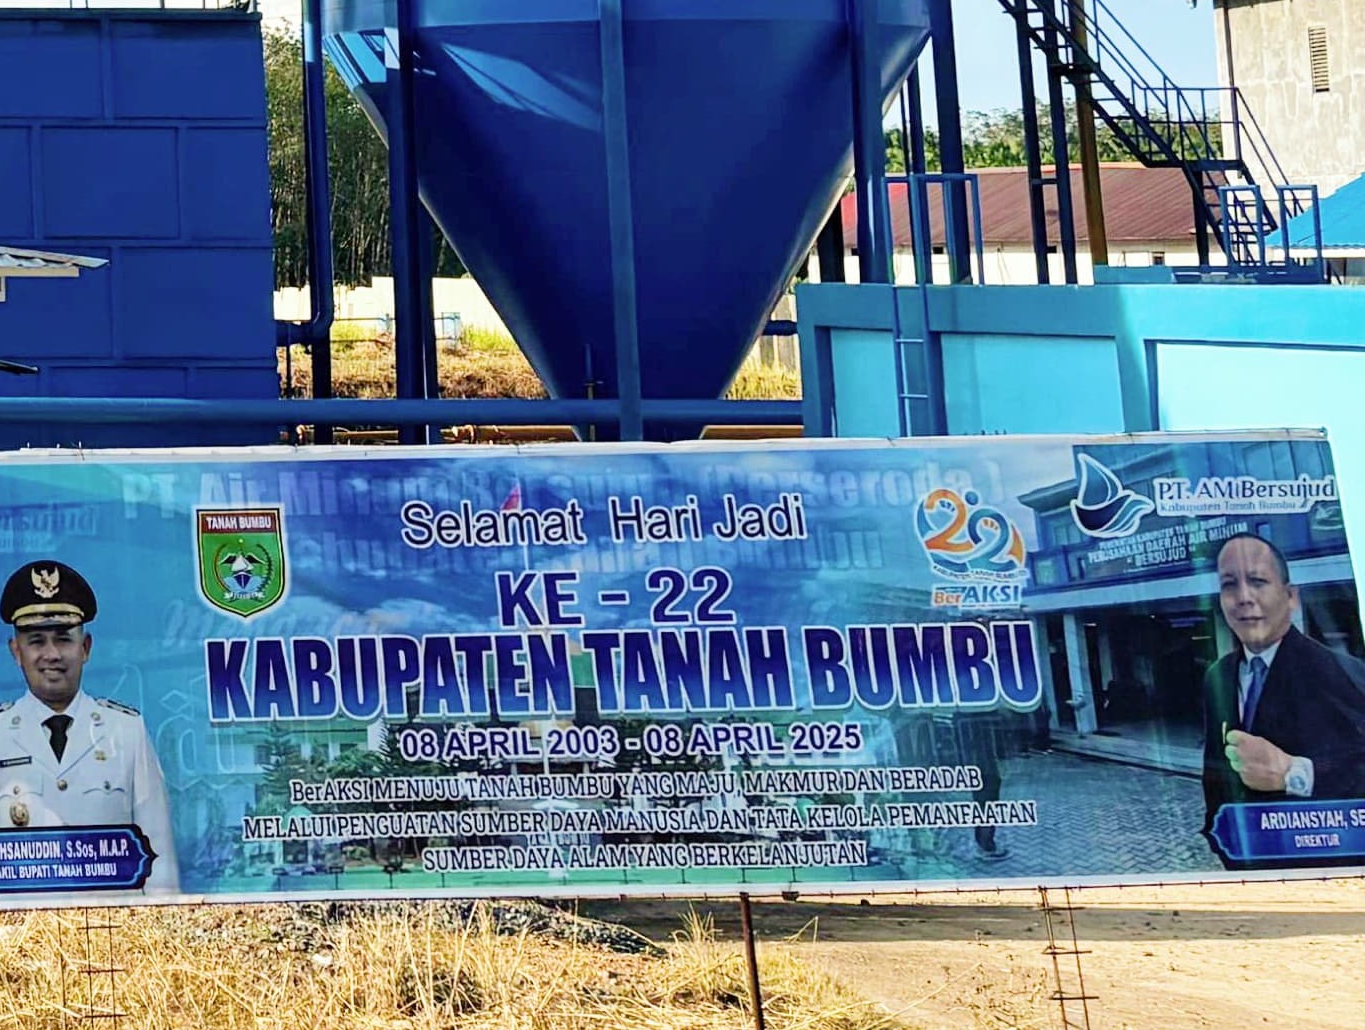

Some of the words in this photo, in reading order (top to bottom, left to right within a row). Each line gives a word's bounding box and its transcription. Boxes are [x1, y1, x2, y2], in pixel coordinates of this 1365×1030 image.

[1241, 477, 1335, 508] Bersujud
[206, 517, 237, 530] TANAH
[239, 516, 272, 529] BUMBU
[403, 501, 585, 545] Selamat
[610, 496, 700, 542] Hari
[717, 494, 806, 540] Jadi
[497, 572, 583, 626] KE
[648, 568, 735, 623] 22
[205, 632, 571, 721] KABUPATEN
[583, 627, 794, 712] TANAH
[802, 623, 1042, 710] BUMBU
[402, 732, 437, 758] 08
[446, 730, 539, 757] APRIL
[549, 727, 618, 756] 2003
[645, 729, 680, 754] 08
[691, 727, 782, 753] APRIL
[792, 724, 861, 750] 2025
[292, 779, 370, 802] BerAKSI
[375, 778, 459, 800] MENUJU
[466, 776, 538, 799] TANAH
[539, 774, 611, 797] BUMBU
[616, 774, 674, 796] YANG
[746, 771, 840, 794] MAKMUR
[842, 770, 885, 791] DAN
[892, 768, 983, 790] BERADAB
[244, 816, 335, 839] MELALUI
[338, 814, 456, 837] PENGUATAN
[461, 812, 545, 835] SUMBER
[550, 811, 601, 833] DAYA
[605, 810, 704, 833] MANUSIA
[706, 809, 749, 831] DAN
[752, 807, 803, 830] TATA
[807, 806, 886, 829] KELOLA
[888, 803, 1037, 827] PEMANFAATAN
[1261, 810, 1349, 830] ARDIANSYAH,
[99, 839, 129, 857] M.A.P.
[1295, 833, 1340, 848] DIREKTUR
[19, 865, 50, 879] BUPATI
[52, 864, 83, 878] TANAH
[85, 863, 117, 876] BUMBU
[423, 848, 511, 871] SUMBER
[513, 847, 564, 869] DAYA
[568, 846, 628, 868] ALAM
[631, 845, 689, 867] YANG
[692, 842, 868, 866] BERKELANJUTAN
